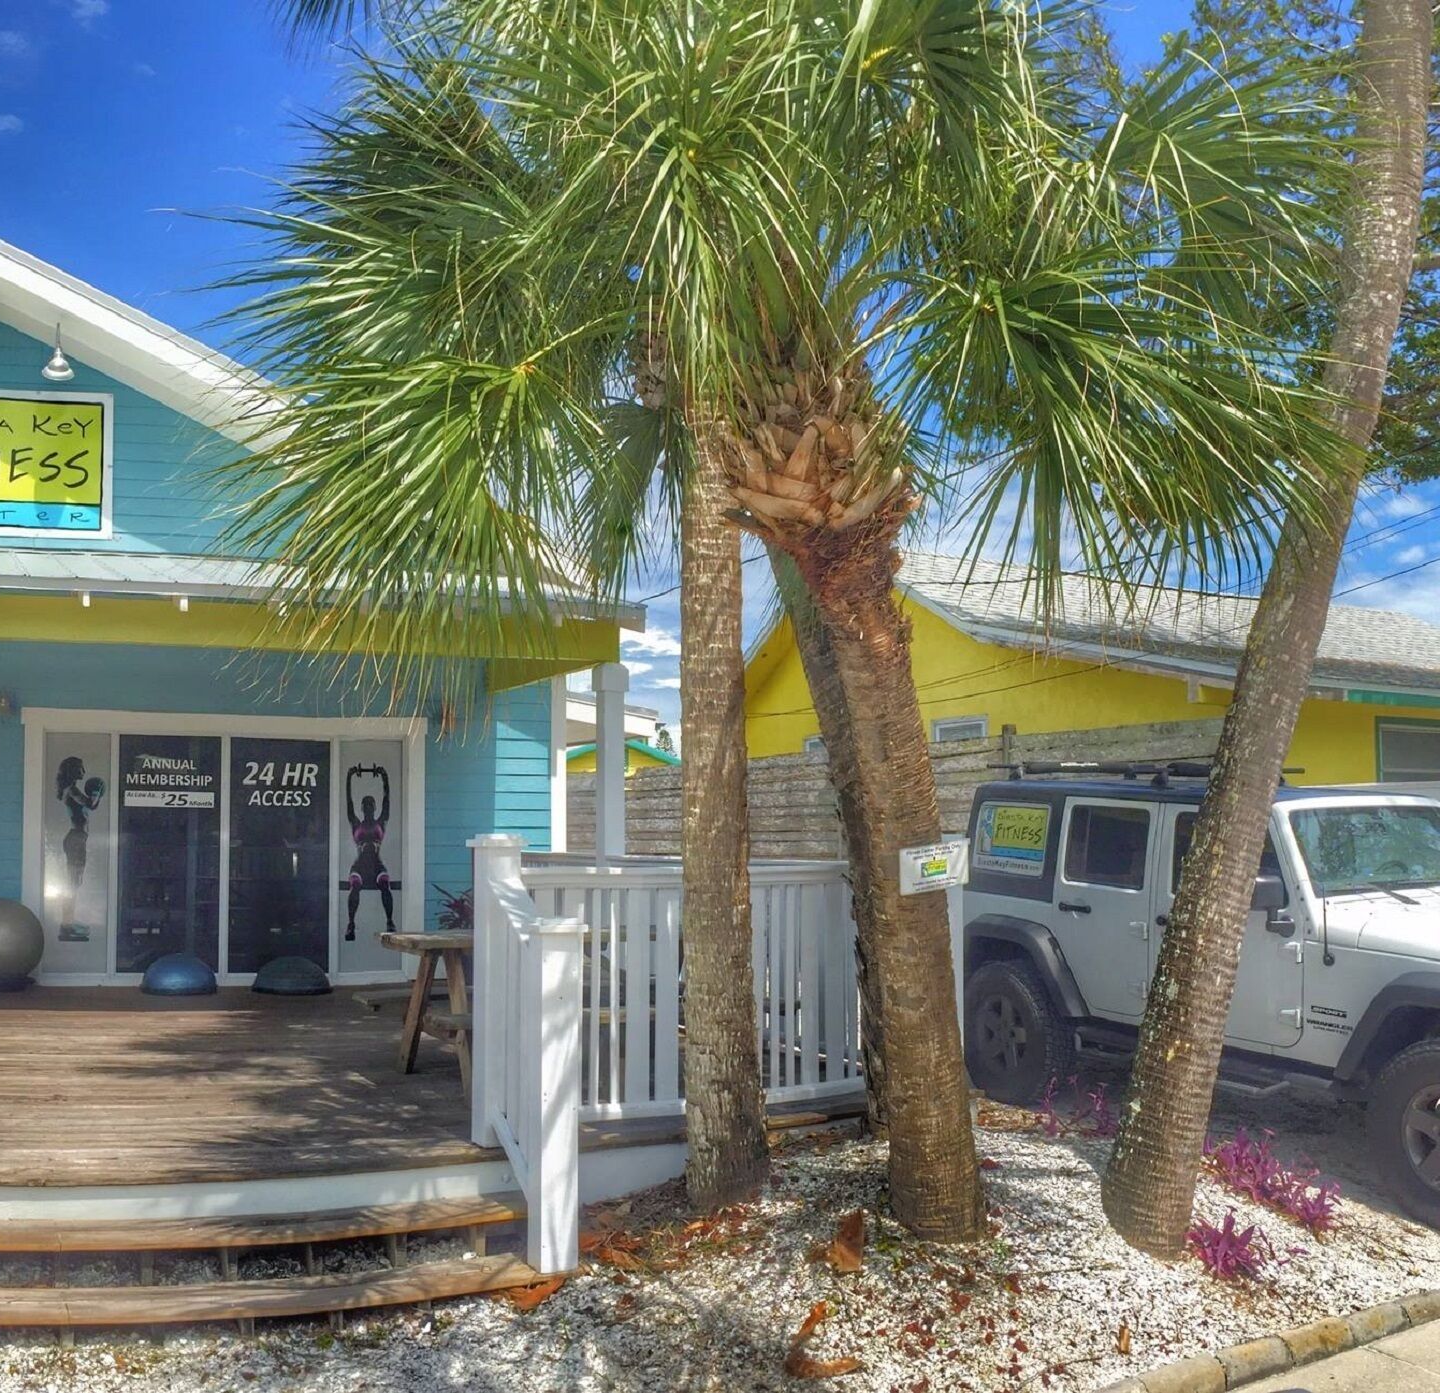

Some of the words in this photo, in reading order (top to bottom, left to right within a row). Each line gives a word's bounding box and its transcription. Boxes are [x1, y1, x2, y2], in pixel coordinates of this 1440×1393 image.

[142, 758, 197, 770] ANNUAL
[126, 773, 213, 787] MEMBERSHIP
[242, 761, 275, 786] 24
[281, 762, 319, 787] HR
[248, 790, 312, 807] ACCESS
[995, 823, 1043, 845] FITNESS
[1312, 1006, 1345, 1016] SPORT
